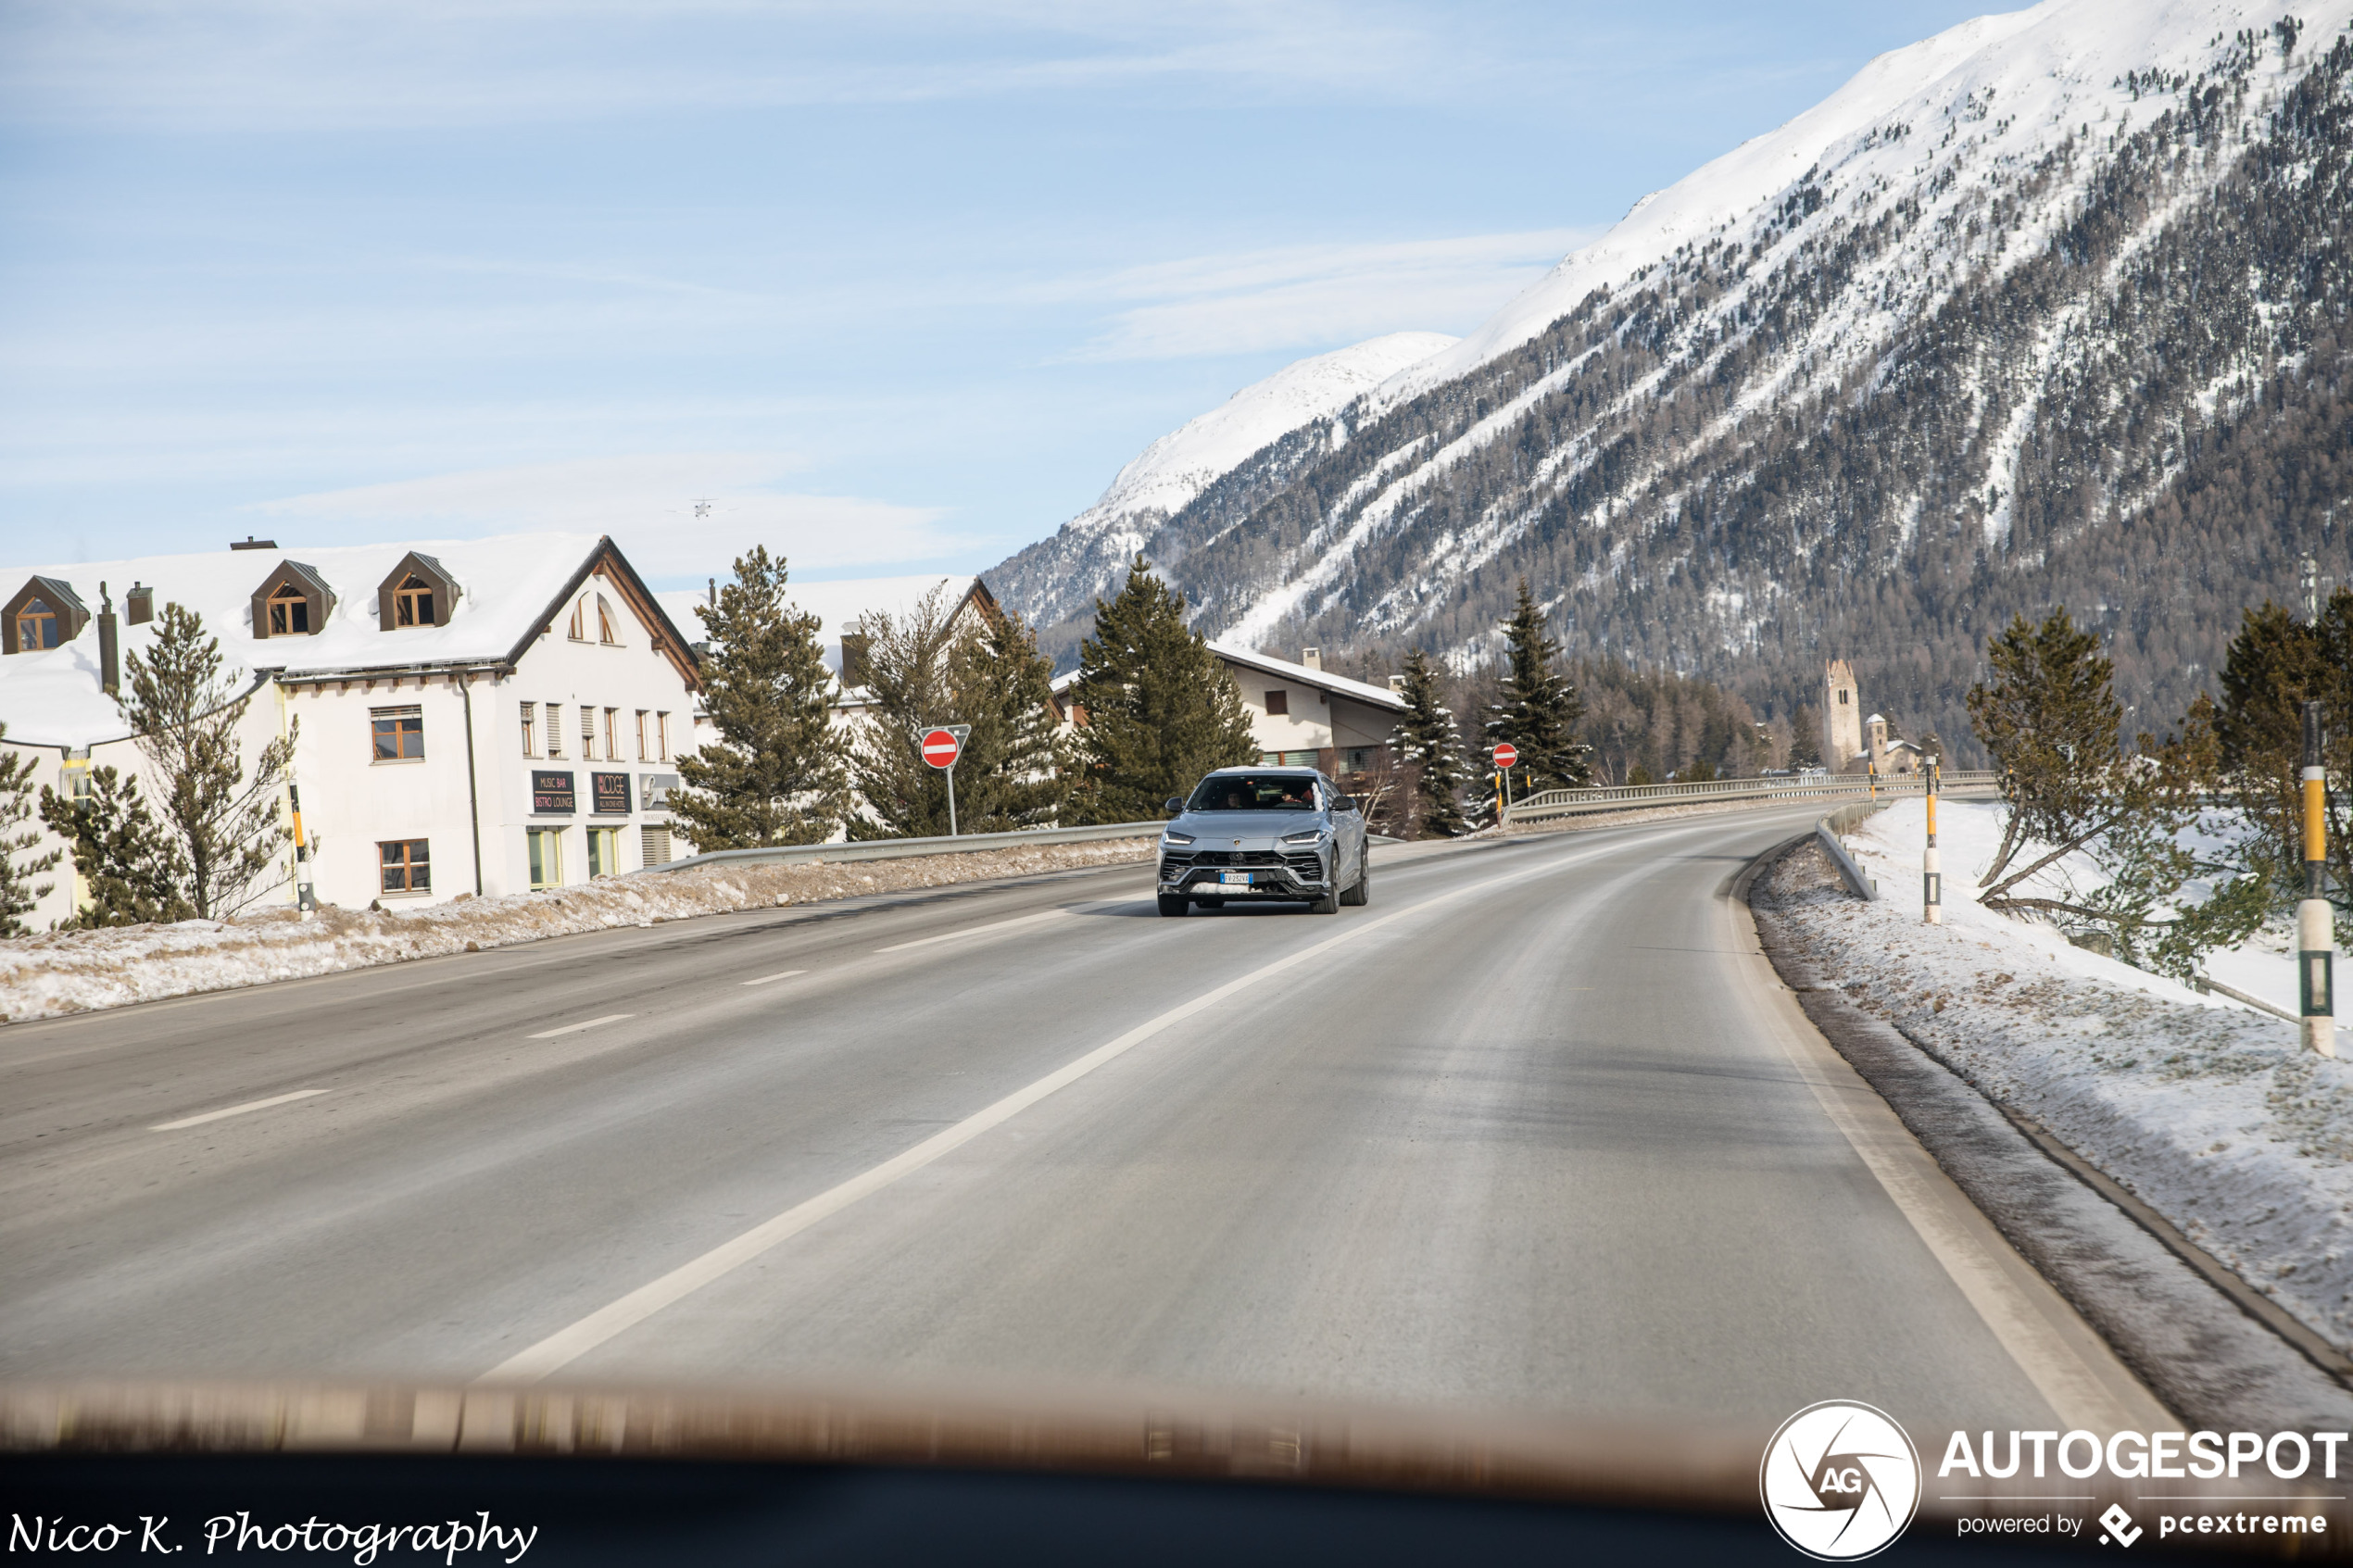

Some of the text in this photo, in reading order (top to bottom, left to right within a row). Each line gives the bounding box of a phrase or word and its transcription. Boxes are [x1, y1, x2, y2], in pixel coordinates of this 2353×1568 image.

[540, 777, 567, 788] MUSIC BAR
[603, 774, 624, 795] LODGE
[535, 797, 573, 808] BISTRO LOUNGE
